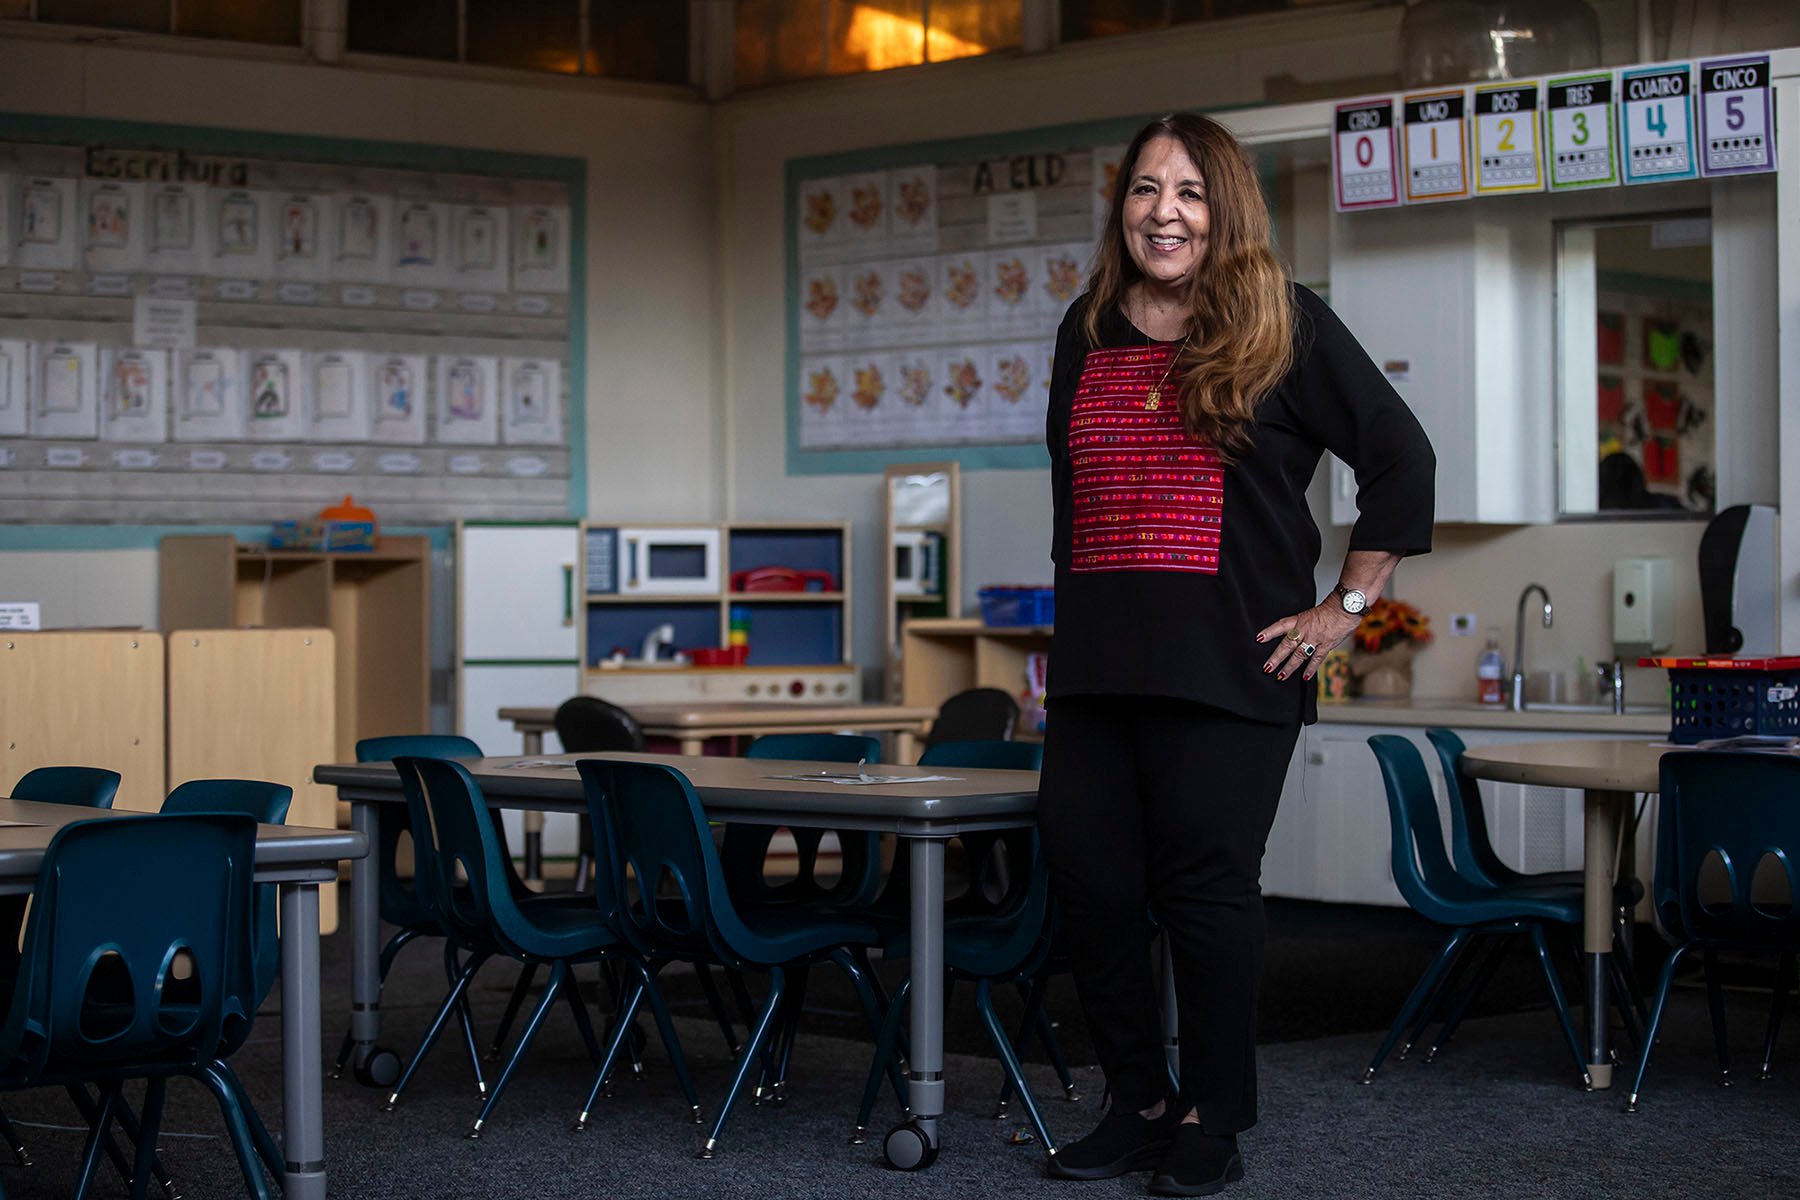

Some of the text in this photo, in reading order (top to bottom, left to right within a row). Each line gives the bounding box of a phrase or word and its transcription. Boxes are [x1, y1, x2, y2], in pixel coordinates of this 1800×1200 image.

[1566, 85, 1595, 106] TRES
[1629, 76, 1683, 99] CUATRO
[1713, 68, 1758, 91] CINCO
[1419, 101, 1449, 121] UNO
[1492, 93, 1520, 112] DOS
[1725, 96, 1745, 131] 5
[1349, 111, 1380, 129] CERO
[1497, 118, 1516, 151] 2
[1572, 112, 1589, 145] 3
[1646, 104, 1667, 138] 4
[1356, 135, 1373, 167] 0
[1430, 127, 1438, 160] 1
[86, 145, 248, 186] Escritura
[974, 154, 1065, 194] A ELD
